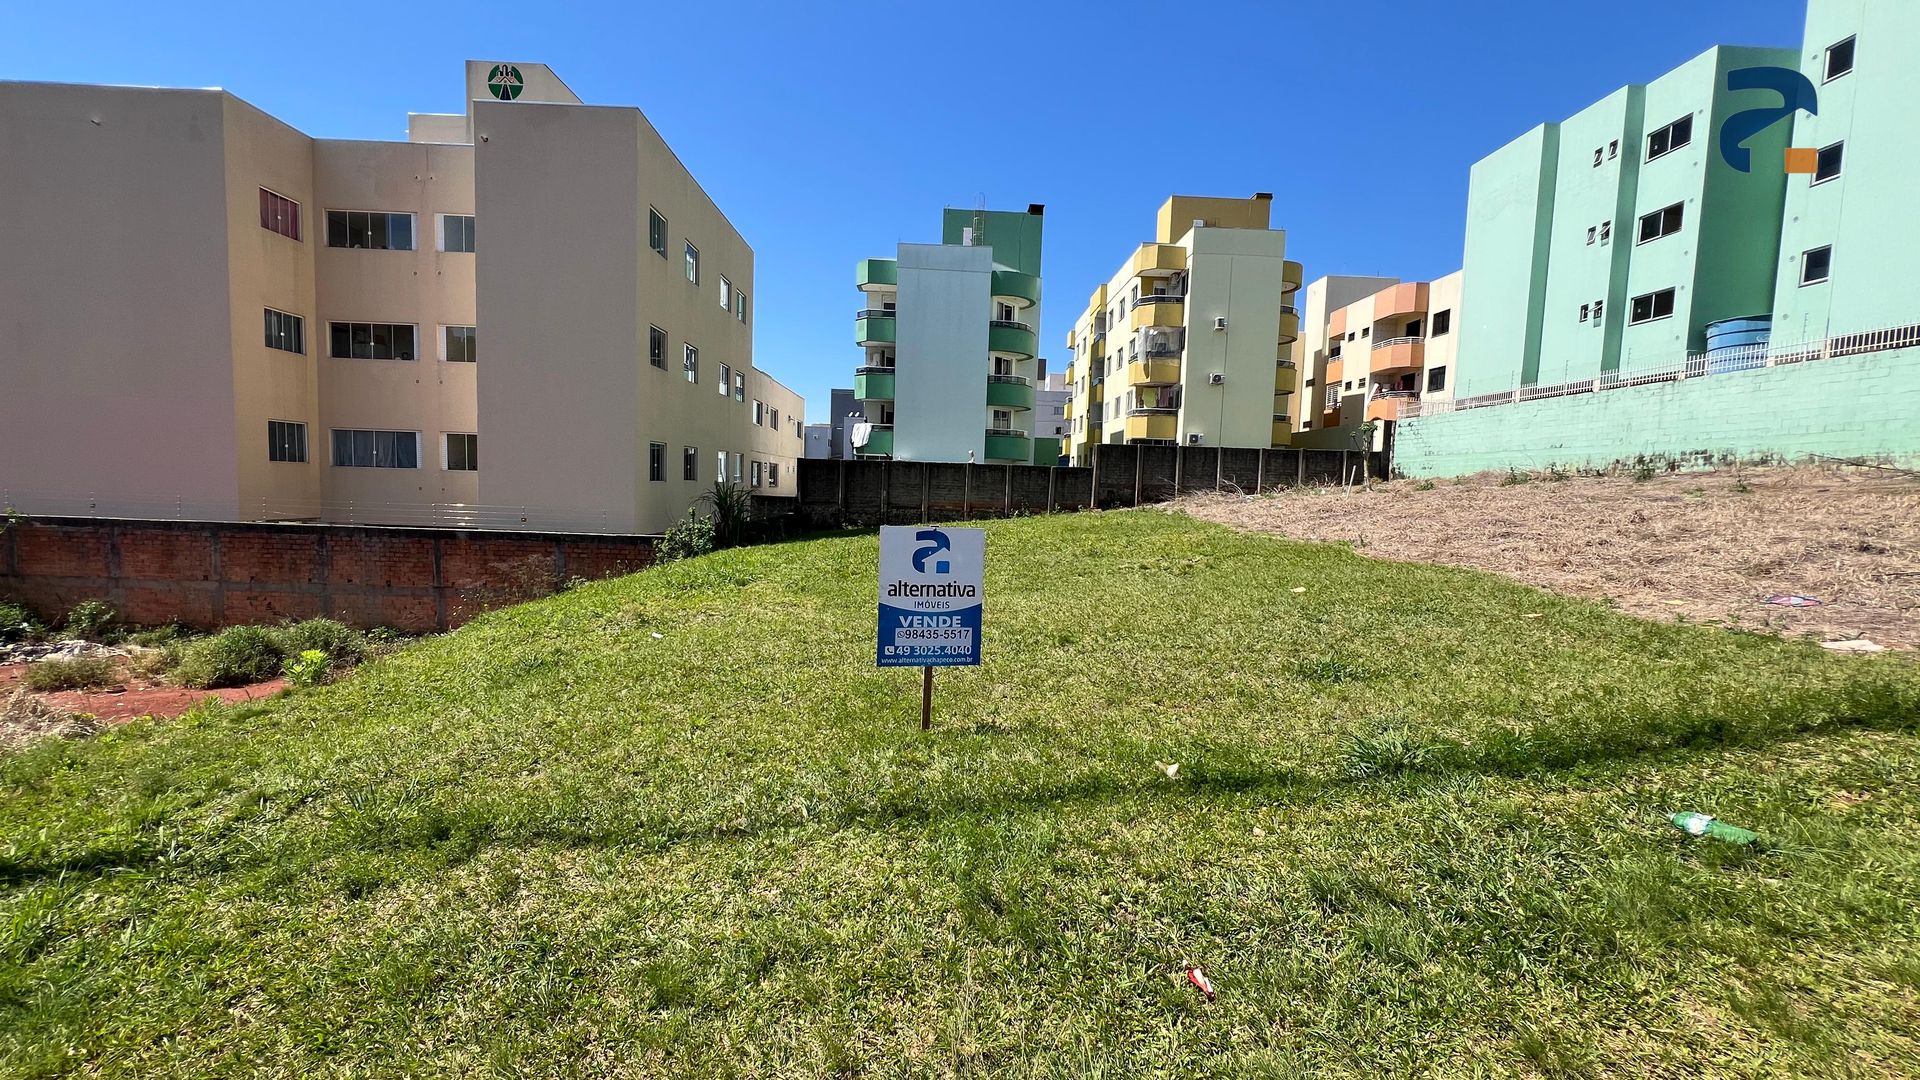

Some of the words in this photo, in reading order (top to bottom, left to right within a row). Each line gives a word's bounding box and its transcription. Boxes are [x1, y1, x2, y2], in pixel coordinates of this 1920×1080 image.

[887, 580, 976, 598] alternativa
[914, 600, 950, 609] IMÓVEIS
[899, 615, 962, 628] VENDE
[904, 629, 970, 640] 98435-5517
[896, 646, 911, 656] 49
[913, 646, 972, 656] 3025.4040
[881, 656, 974, 664] www.alternativachapeco.com.br
